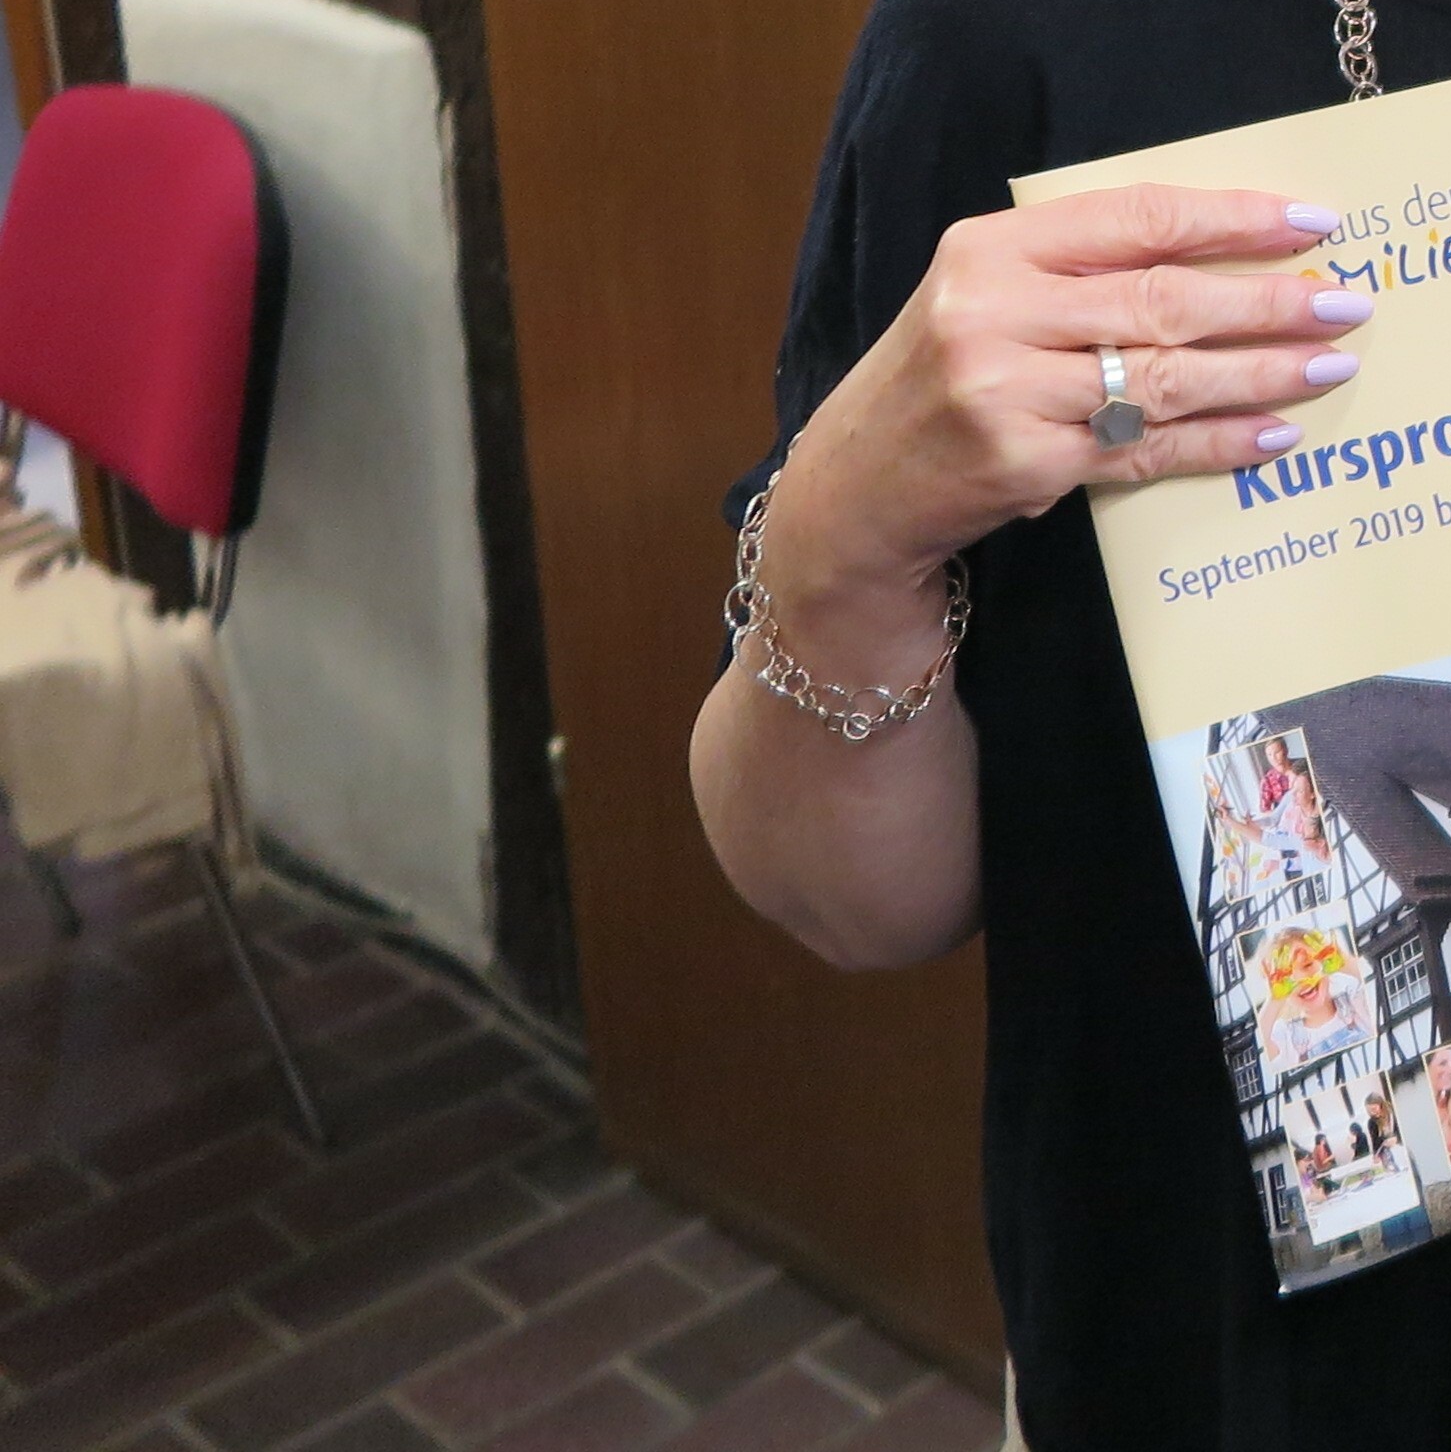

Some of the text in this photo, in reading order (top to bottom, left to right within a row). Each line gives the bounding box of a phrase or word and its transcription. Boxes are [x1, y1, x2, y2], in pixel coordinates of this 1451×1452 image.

[1319, 203, 1391, 248] aus
[1158, 528, 1340, 604] September
[1348, 501, 1424, 549] 2019
